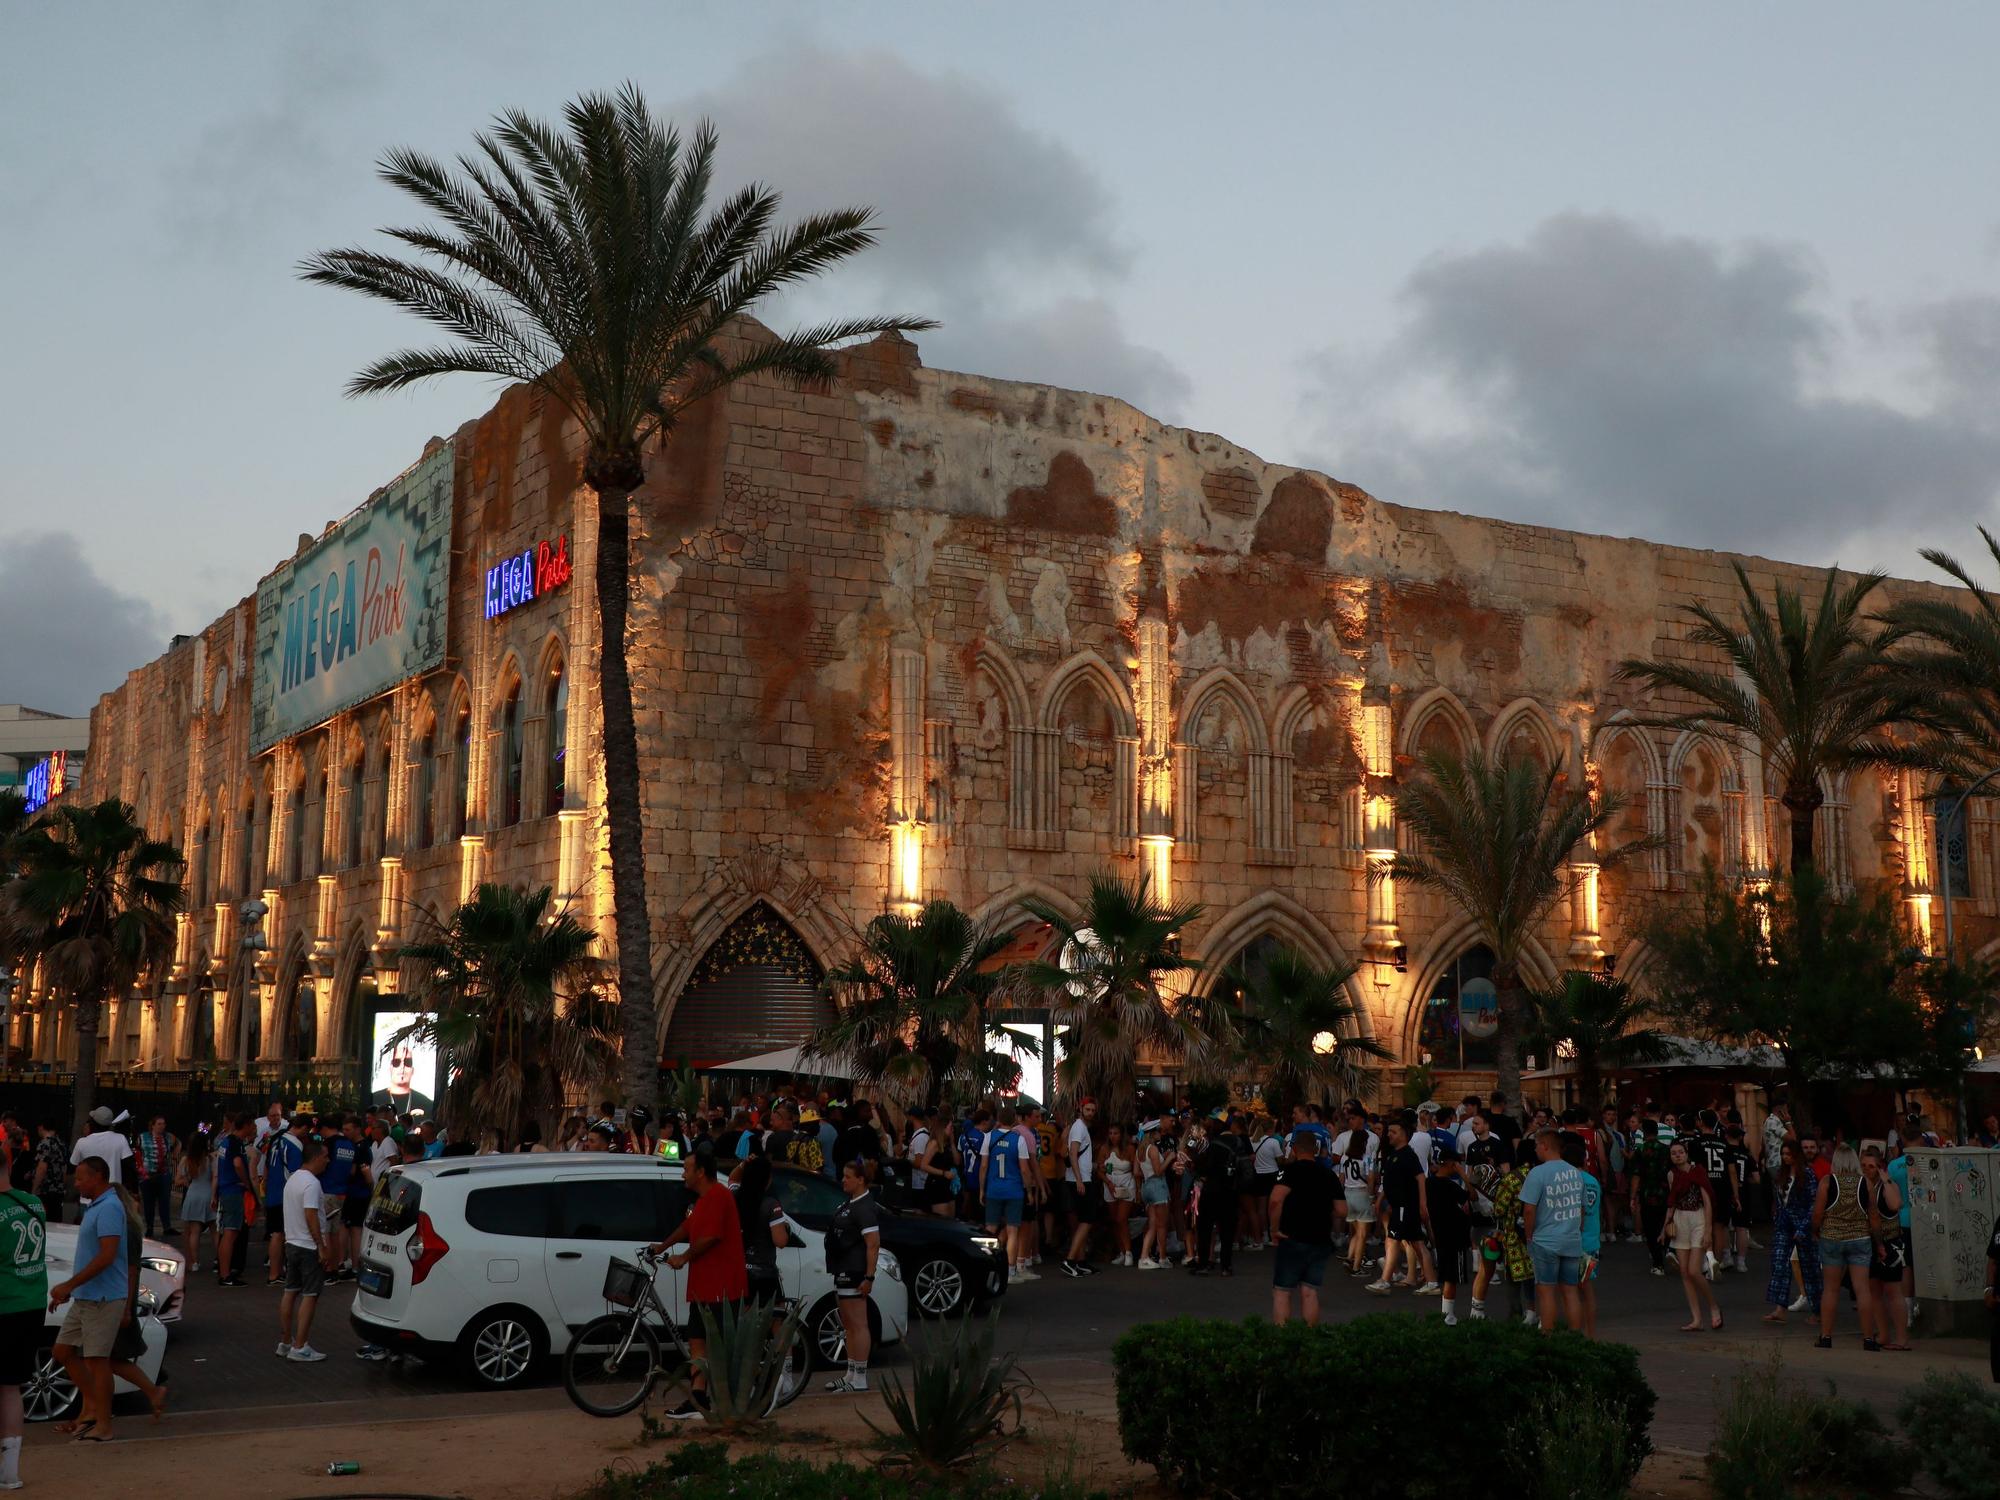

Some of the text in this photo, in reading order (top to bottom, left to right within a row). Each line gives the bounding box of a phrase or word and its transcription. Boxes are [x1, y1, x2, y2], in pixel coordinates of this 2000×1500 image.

[485, 535, 571, 621] MEGA Park
[281, 543, 408, 695] MEGA Park
[996, 1153, 1005, 1178] 1
[1554, 1169, 1578, 1182] ANTI
[1704, 1148, 1724, 1172] 15
[11, 1217, 44, 1265] 29
